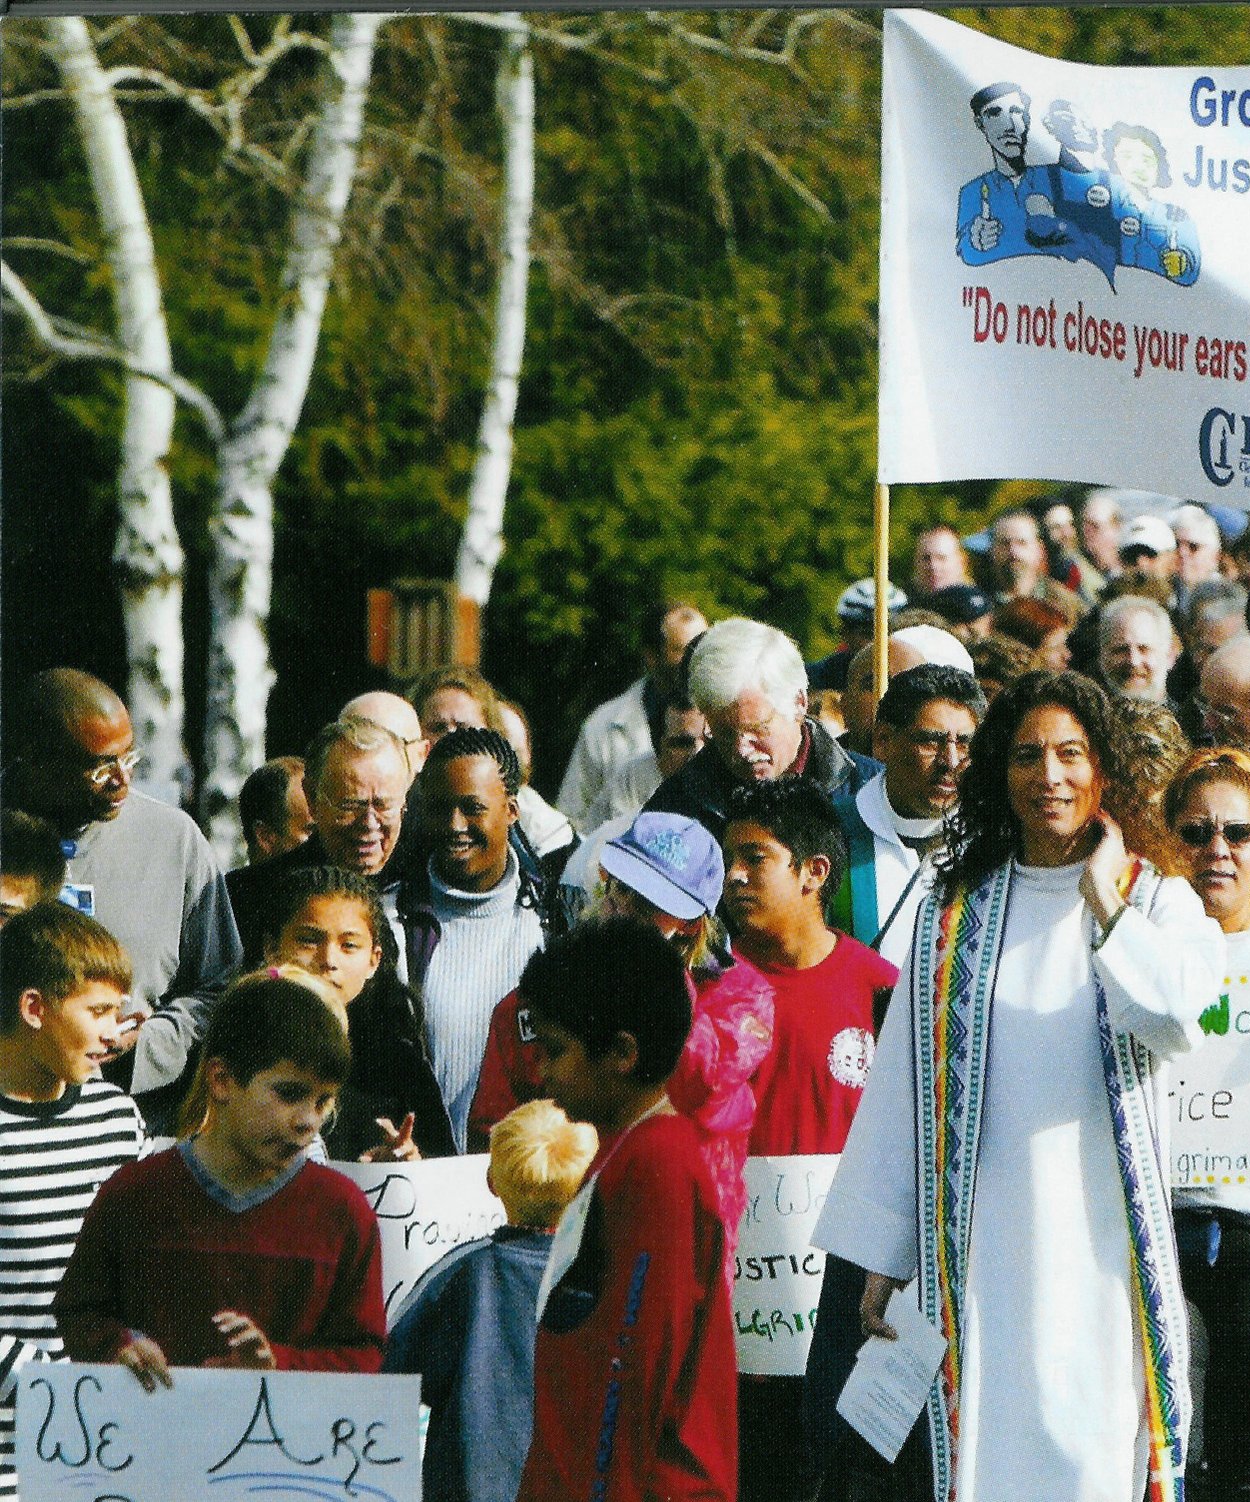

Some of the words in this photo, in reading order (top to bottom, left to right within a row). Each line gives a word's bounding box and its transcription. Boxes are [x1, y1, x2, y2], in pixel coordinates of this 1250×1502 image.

[962, 286, 1009, 344] "Do
[1016, 298, 1057, 349] not
[1064, 301, 1127, 361] close
[1133, 324, 1189, 379] your
[1195, 334, 1248, 382] ears
[1167, 1080, 1233, 1123] ice
[735, 1308, 816, 1343] LGRI
